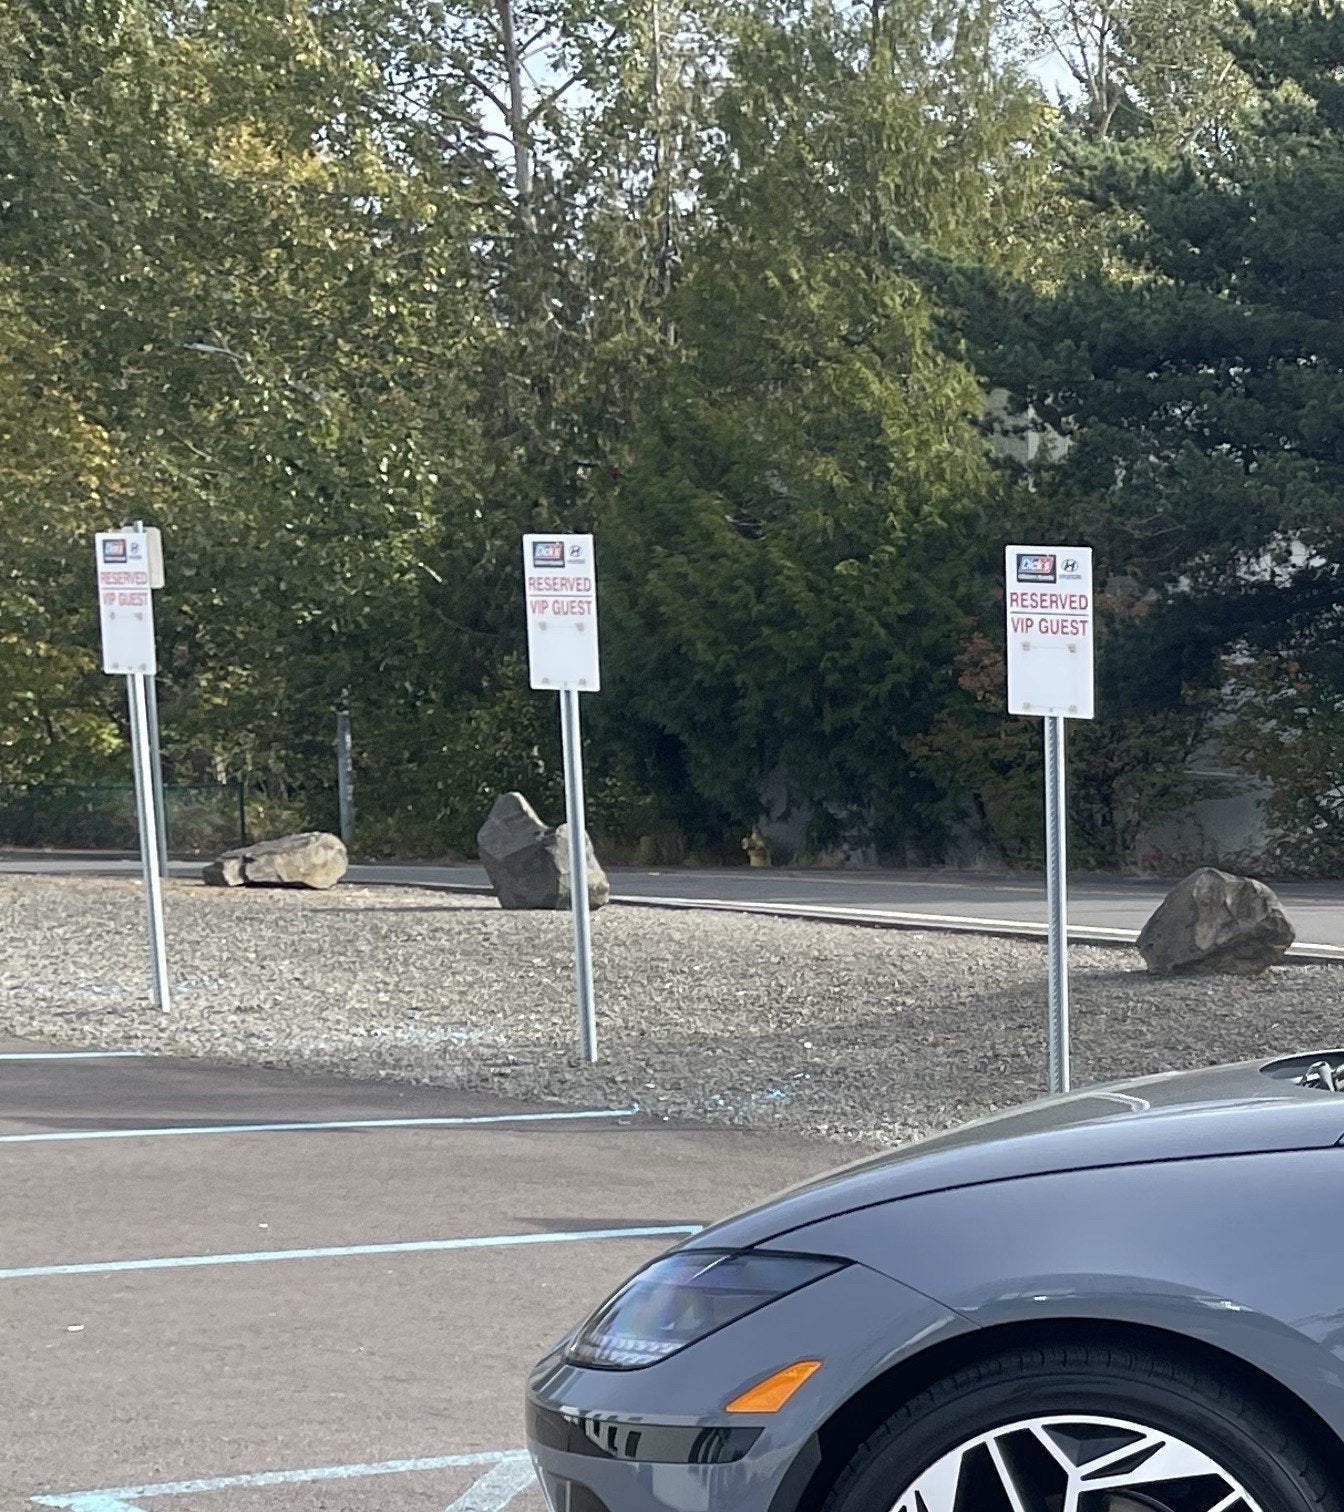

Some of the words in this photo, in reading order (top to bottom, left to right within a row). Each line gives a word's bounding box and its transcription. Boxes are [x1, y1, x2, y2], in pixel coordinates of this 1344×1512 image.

[528, 577, 592, 592] RESERVED
[530, 600, 548, 614] VIP
[552, 600, 592, 615] GUEST
[1010, 592, 1089, 610] RESERVED
[1011, 617, 1034, 633] VIP
[1038, 618, 1088, 636] GUEST
